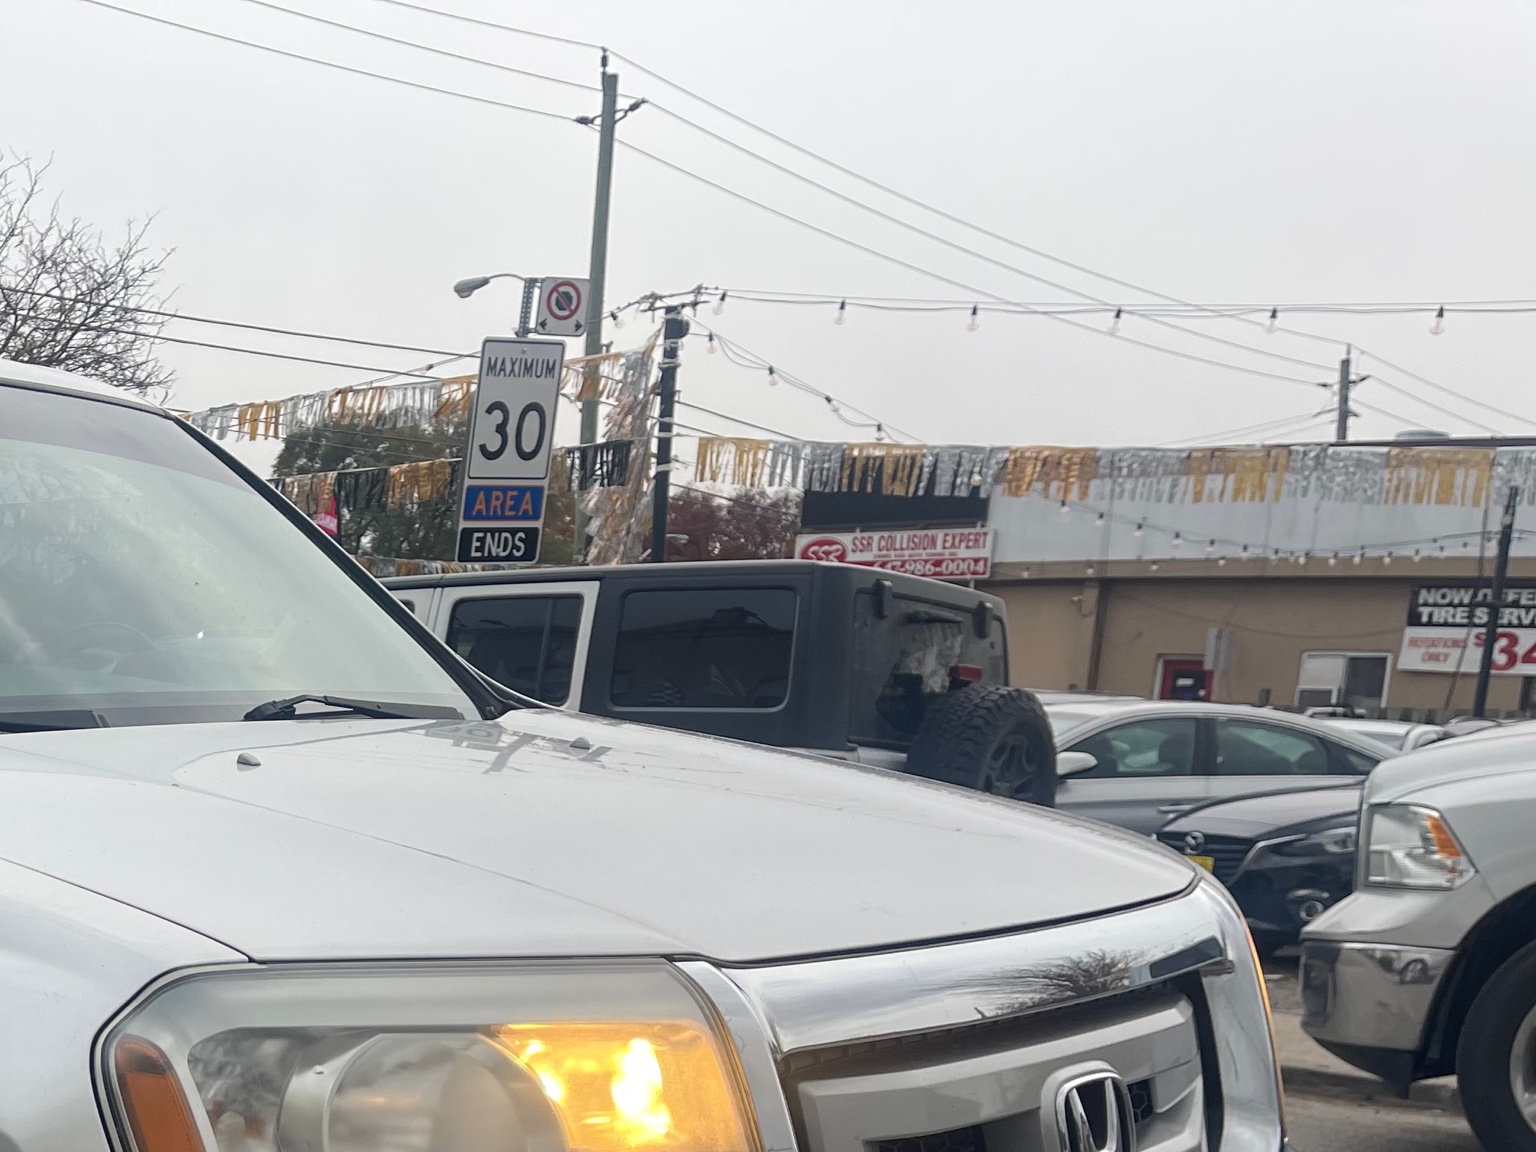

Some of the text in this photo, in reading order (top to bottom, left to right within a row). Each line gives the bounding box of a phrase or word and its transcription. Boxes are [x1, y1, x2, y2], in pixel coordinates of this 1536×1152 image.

[486, 356, 557, 379] MAXIMUM
[478, 400, 547, 461] 30
[472, 490, 534, 516] AREA
[470, 532, 526, 557] ENDS
[851, 531, 989, 553] SSR COLLISION EXPERT
[1417, 587, 1475, 606] NOW
[1417, 606, 1471, 626] TIRE
